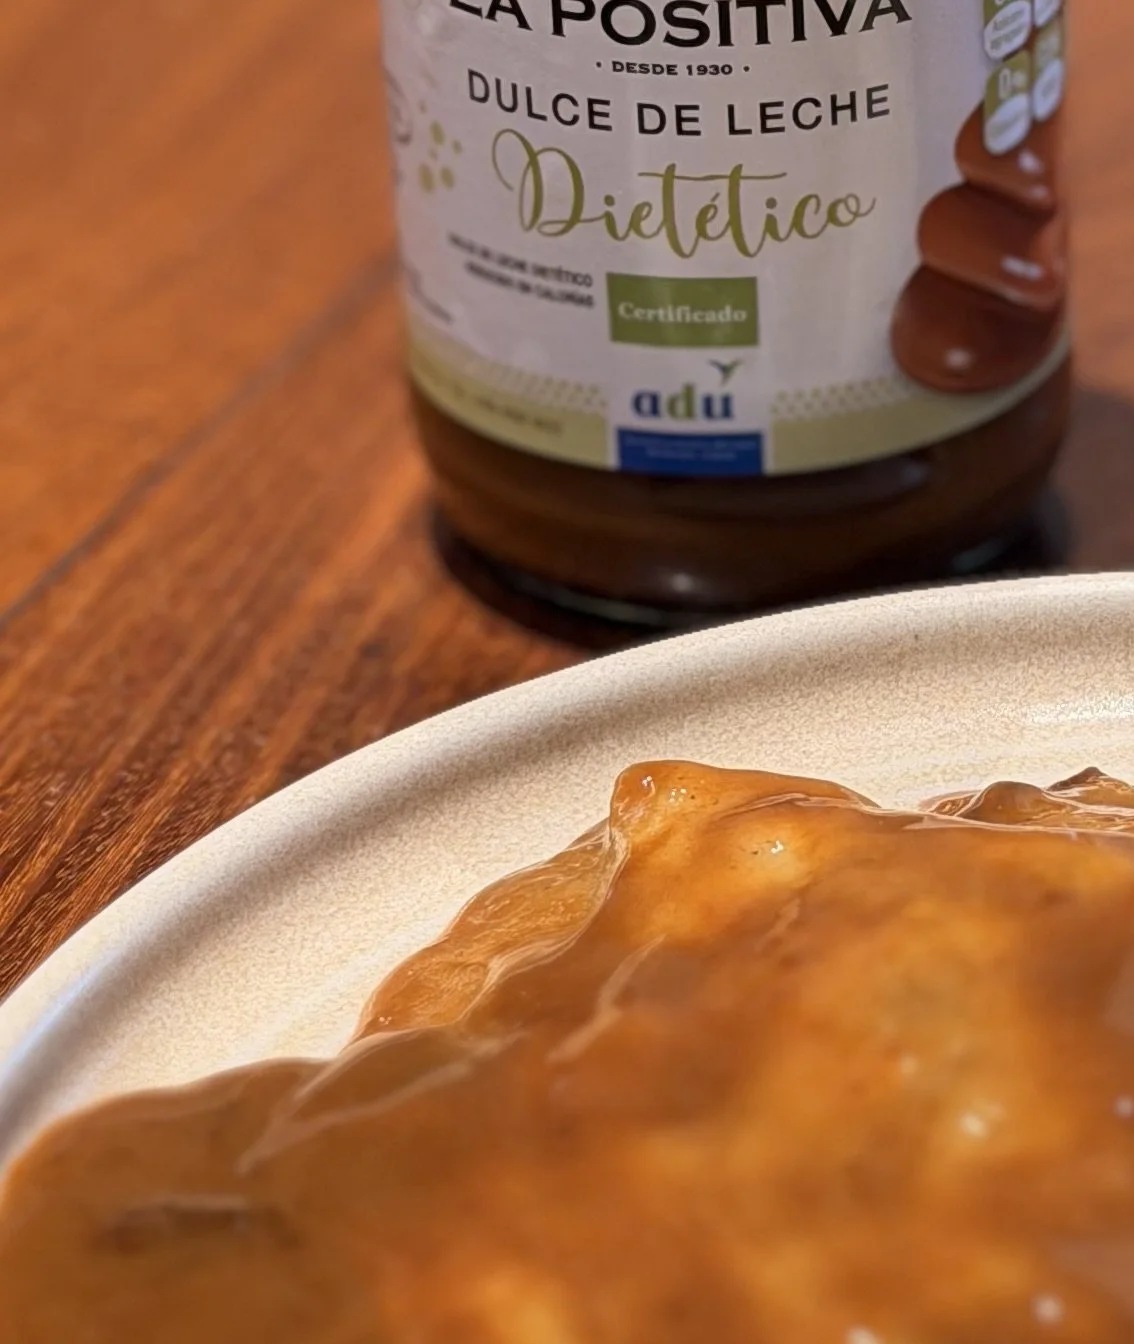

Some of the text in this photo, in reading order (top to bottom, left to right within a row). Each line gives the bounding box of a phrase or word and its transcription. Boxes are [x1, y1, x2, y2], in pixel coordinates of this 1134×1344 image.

[611, 60, 733, 76] DESDE 1930
[467, 68, 891, 136] DULCE DE LECHE
[491, 128, 877, 258] Dietético
[617, 301, 748, 323] Certificado
[630, 382, 734, 421] adu
